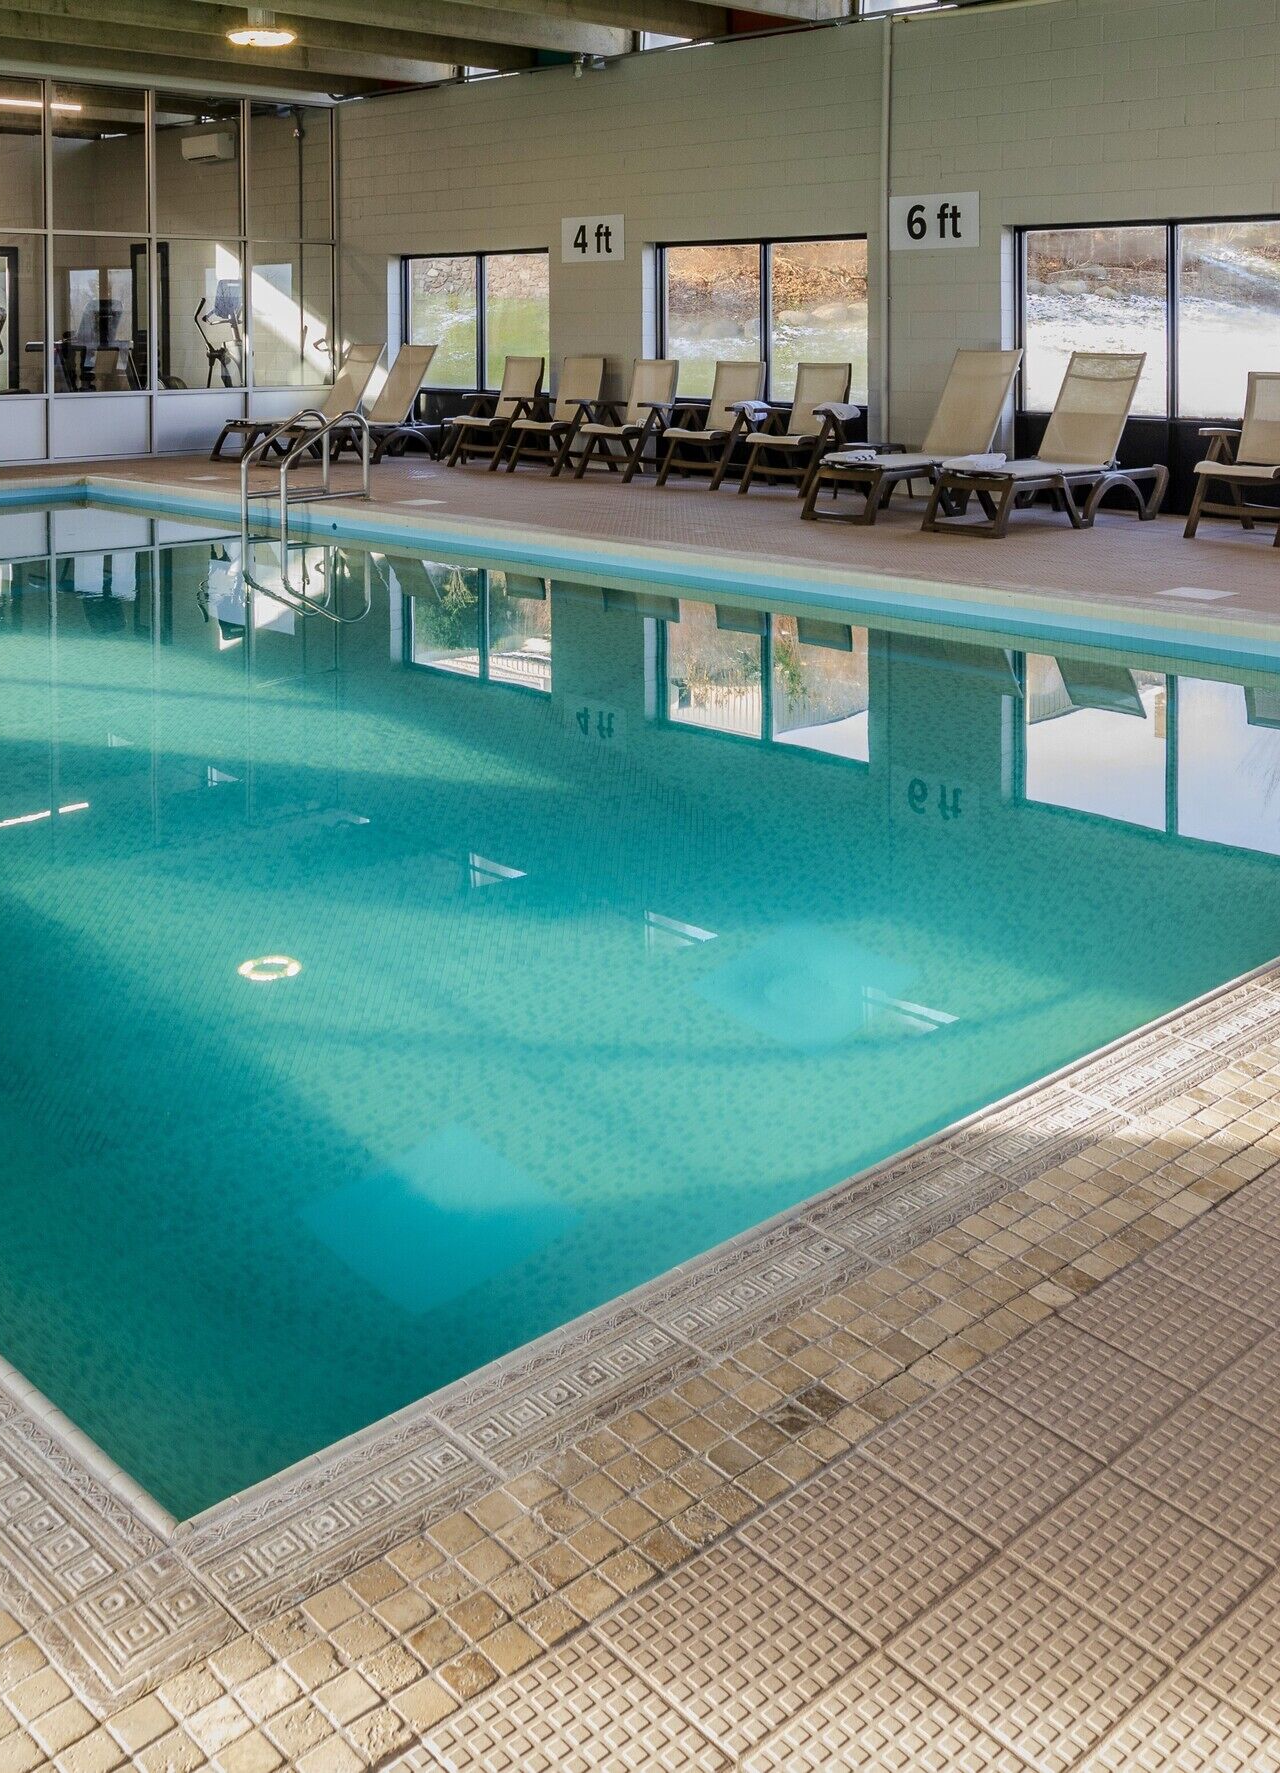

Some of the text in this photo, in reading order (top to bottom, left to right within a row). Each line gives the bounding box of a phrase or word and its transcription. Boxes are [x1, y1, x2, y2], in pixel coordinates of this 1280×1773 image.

[906, 202, 962, 240] 6 ft
[573, 223, 613, 254] 4 ft
